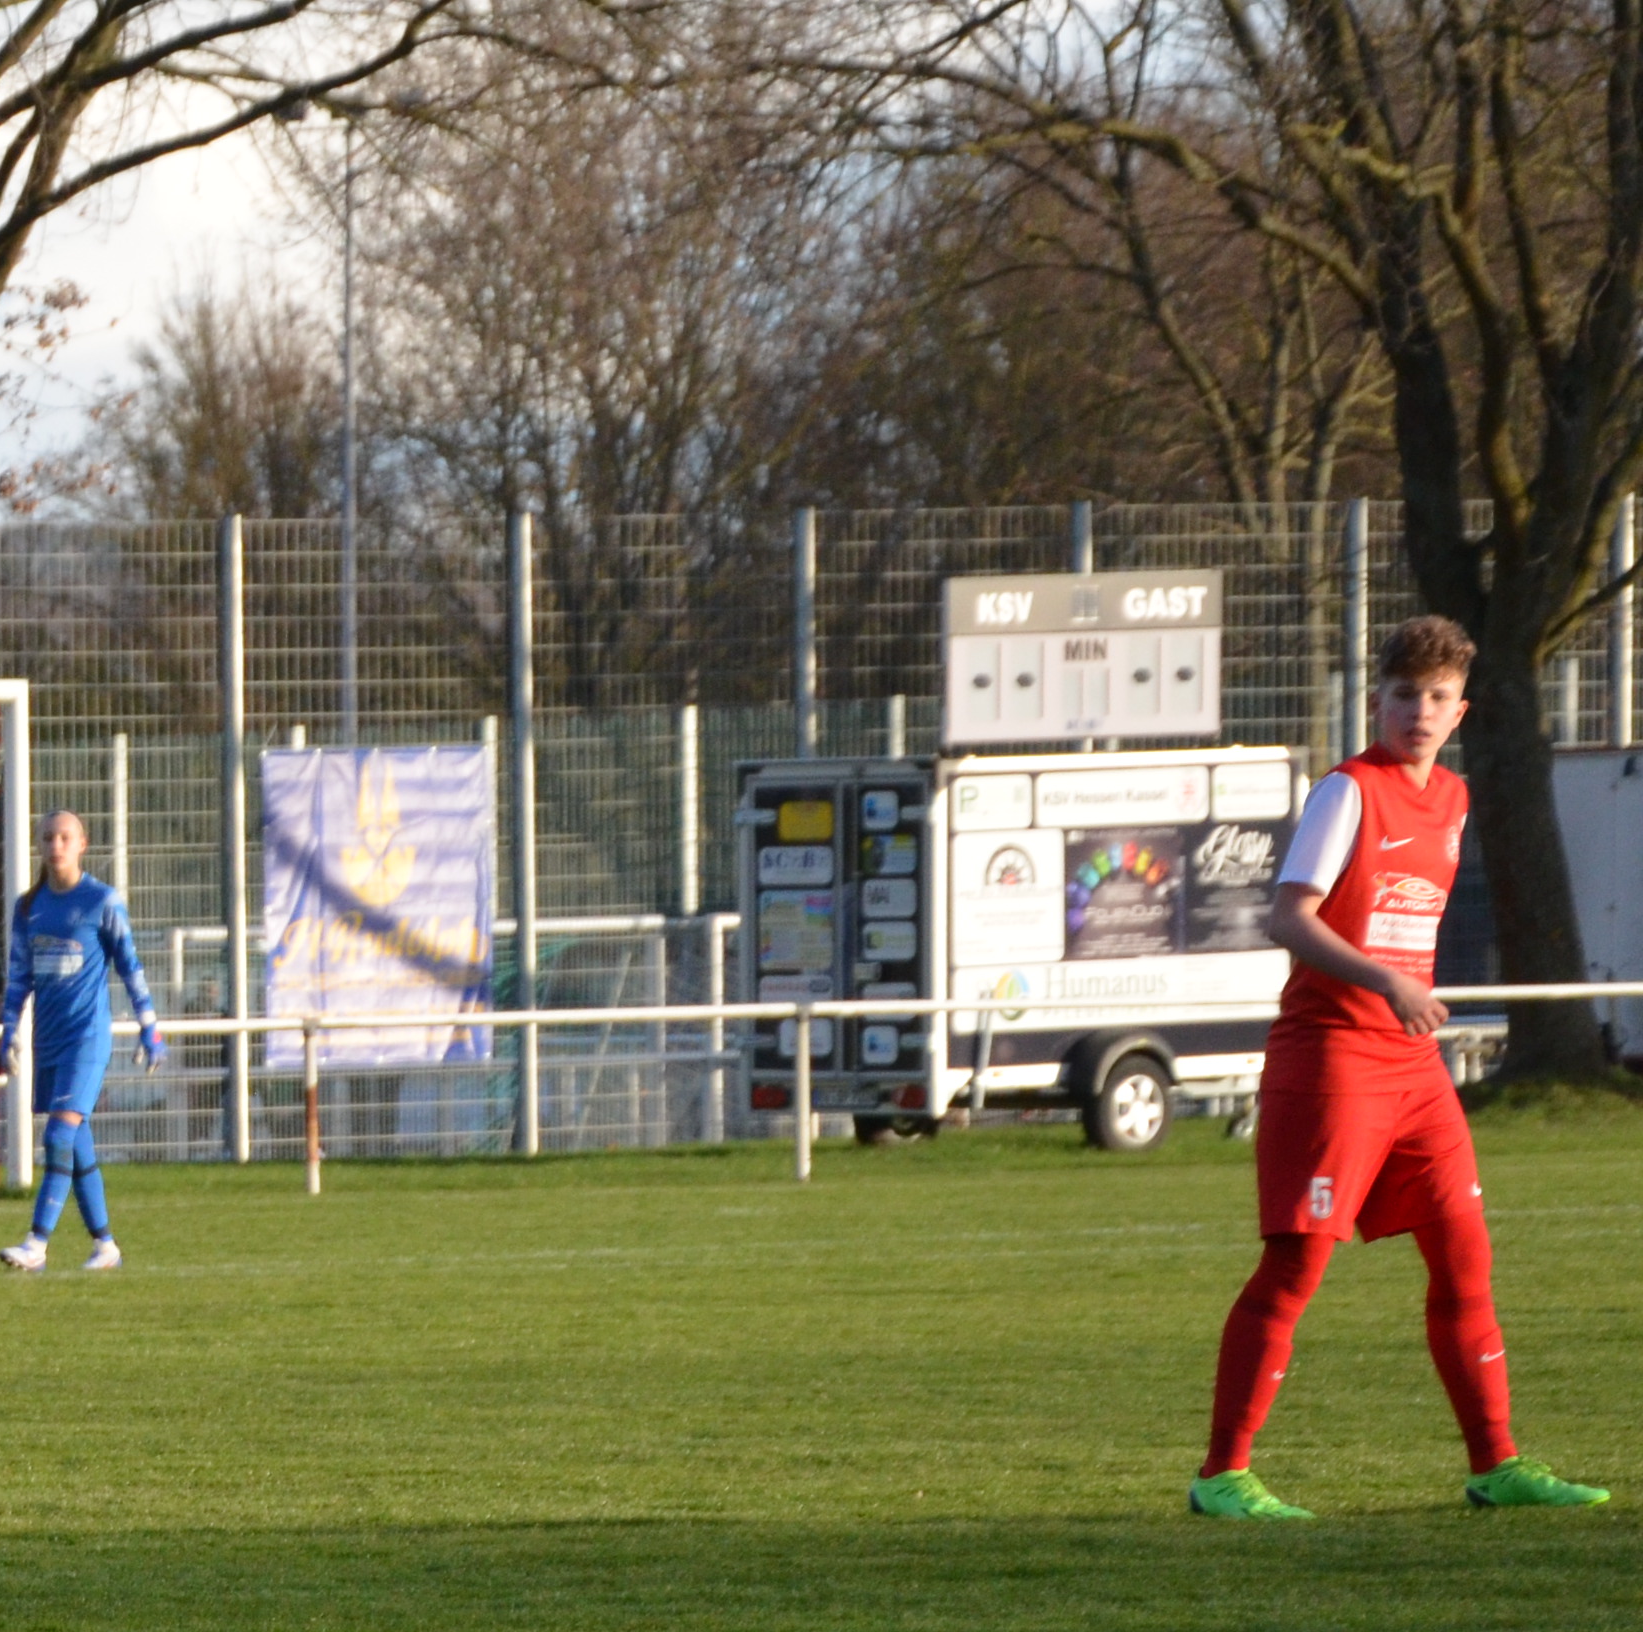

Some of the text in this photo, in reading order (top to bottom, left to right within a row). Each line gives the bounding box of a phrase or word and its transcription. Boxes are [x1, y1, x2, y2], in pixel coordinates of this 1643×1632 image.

[976, 586, 1209, 624] KSV GAST
[1065, 637, 1109, 662] MIN
[1042, 792, 1070, 807] KSV
[1044, 964, 1169, 999] Humanus
[1310, 1176, 1334, 1220] 5
